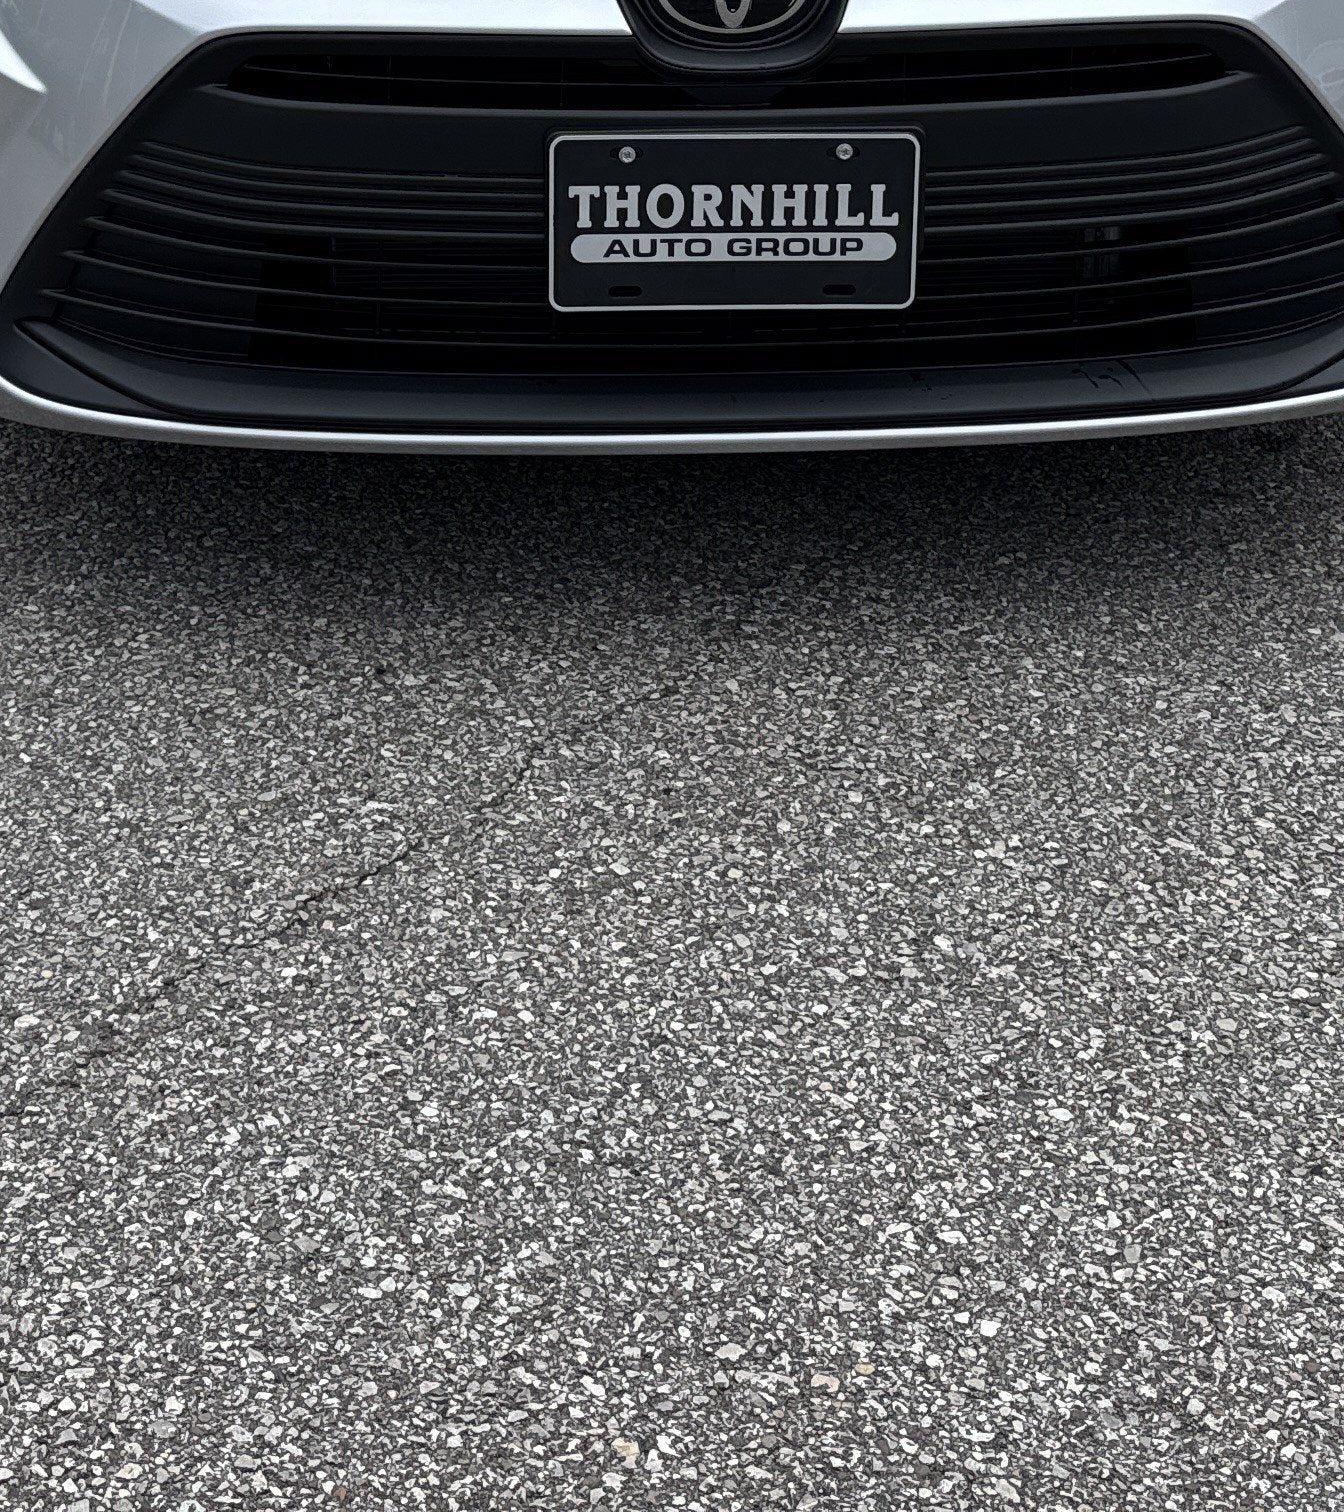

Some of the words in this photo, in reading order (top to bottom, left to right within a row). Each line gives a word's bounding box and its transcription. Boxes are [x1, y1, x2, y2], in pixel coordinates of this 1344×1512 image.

[568, 183, 899, 228] THORNHILL
[603, 238, 712, 258] AUTO
[726, 237, 864, 257] GROUP
